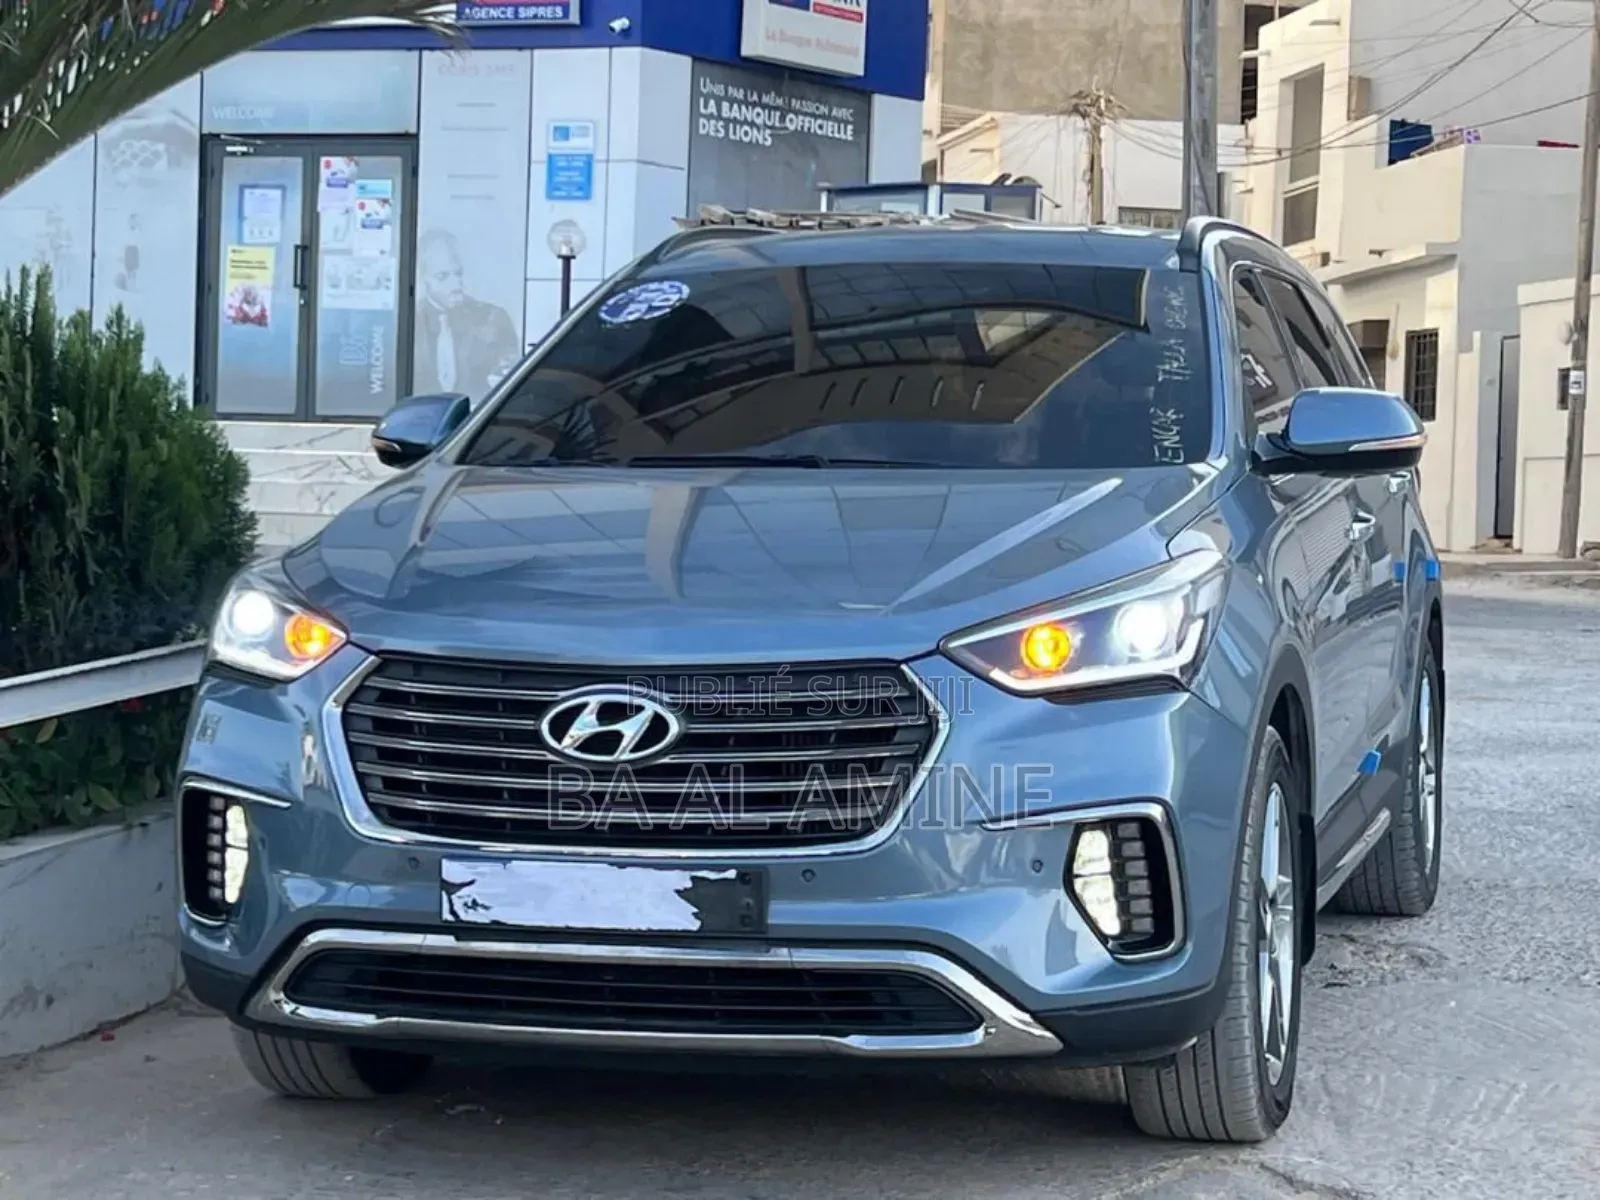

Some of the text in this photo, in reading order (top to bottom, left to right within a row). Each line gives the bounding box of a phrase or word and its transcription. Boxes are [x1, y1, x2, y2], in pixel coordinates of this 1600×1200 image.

[461, 6, 563, 19] AGENCE SIPRES
[700, 97, 717, 116] LA
[786, 113, 854, 141] OFFICIELLE
[728, 85, 745, 101] PAR
[748, 90, 759, 103] LA
[791, 98, 829, 116] PASSION
[831, 106, 854, 121] AVEC
[699, 118, 772, 146] DES LIONS
[369, 325, 385, 394] WELCOME
